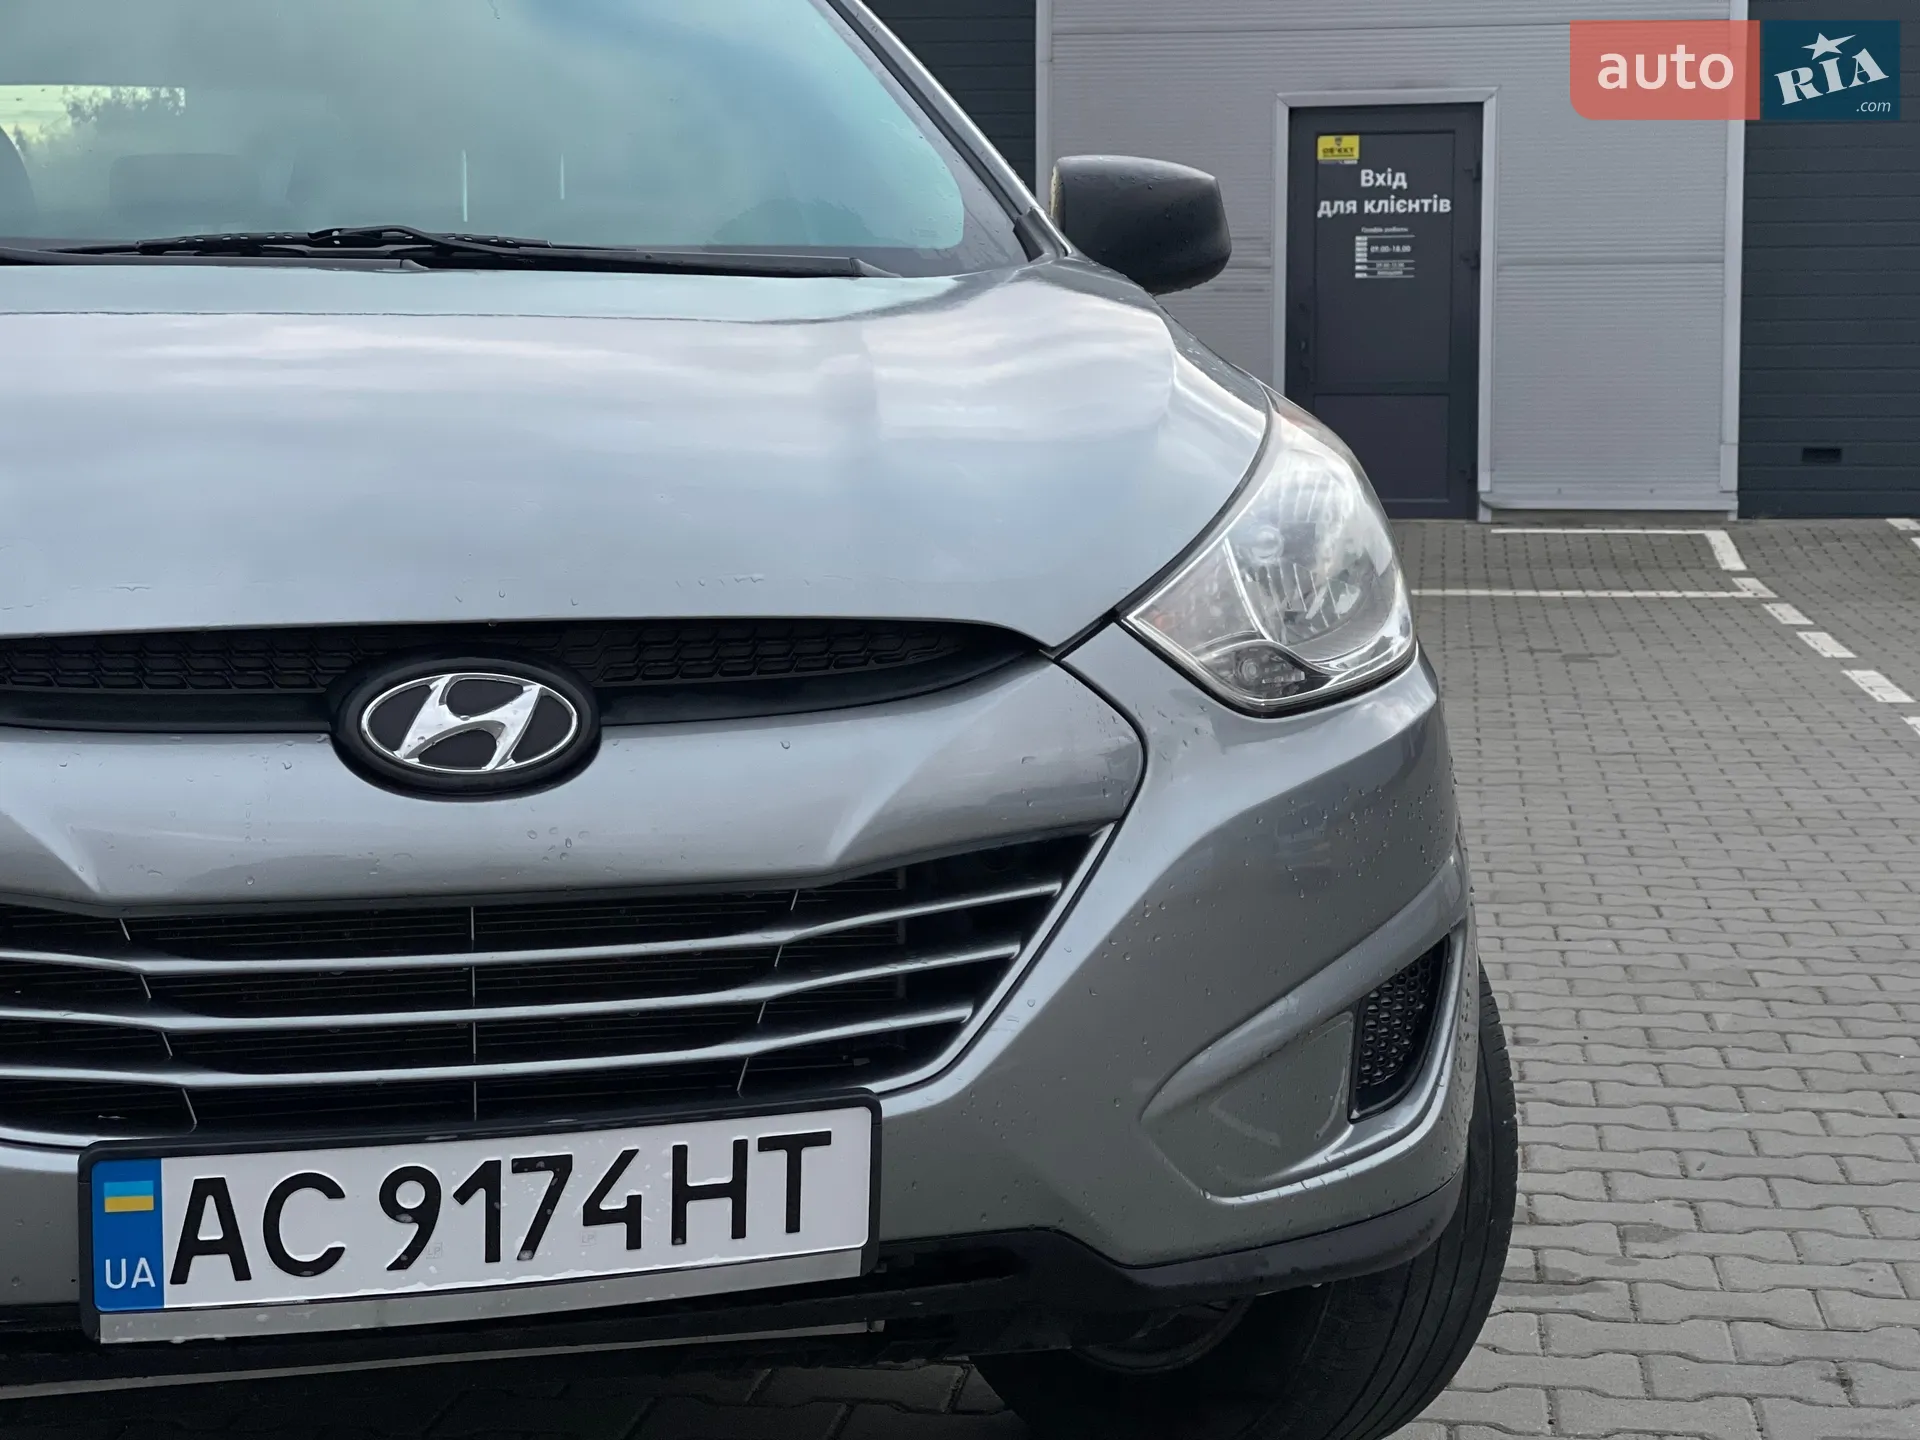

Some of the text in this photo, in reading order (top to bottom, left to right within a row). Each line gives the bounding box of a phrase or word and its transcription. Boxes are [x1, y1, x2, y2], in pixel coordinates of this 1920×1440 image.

[1360, 167, 1408, 190] Вхід
[1317, 194, 1452, 218] для клієнтів
[169, 1130, 832, 1286] AC 9174 HT
[103, 1258, 156, 1290] UA
